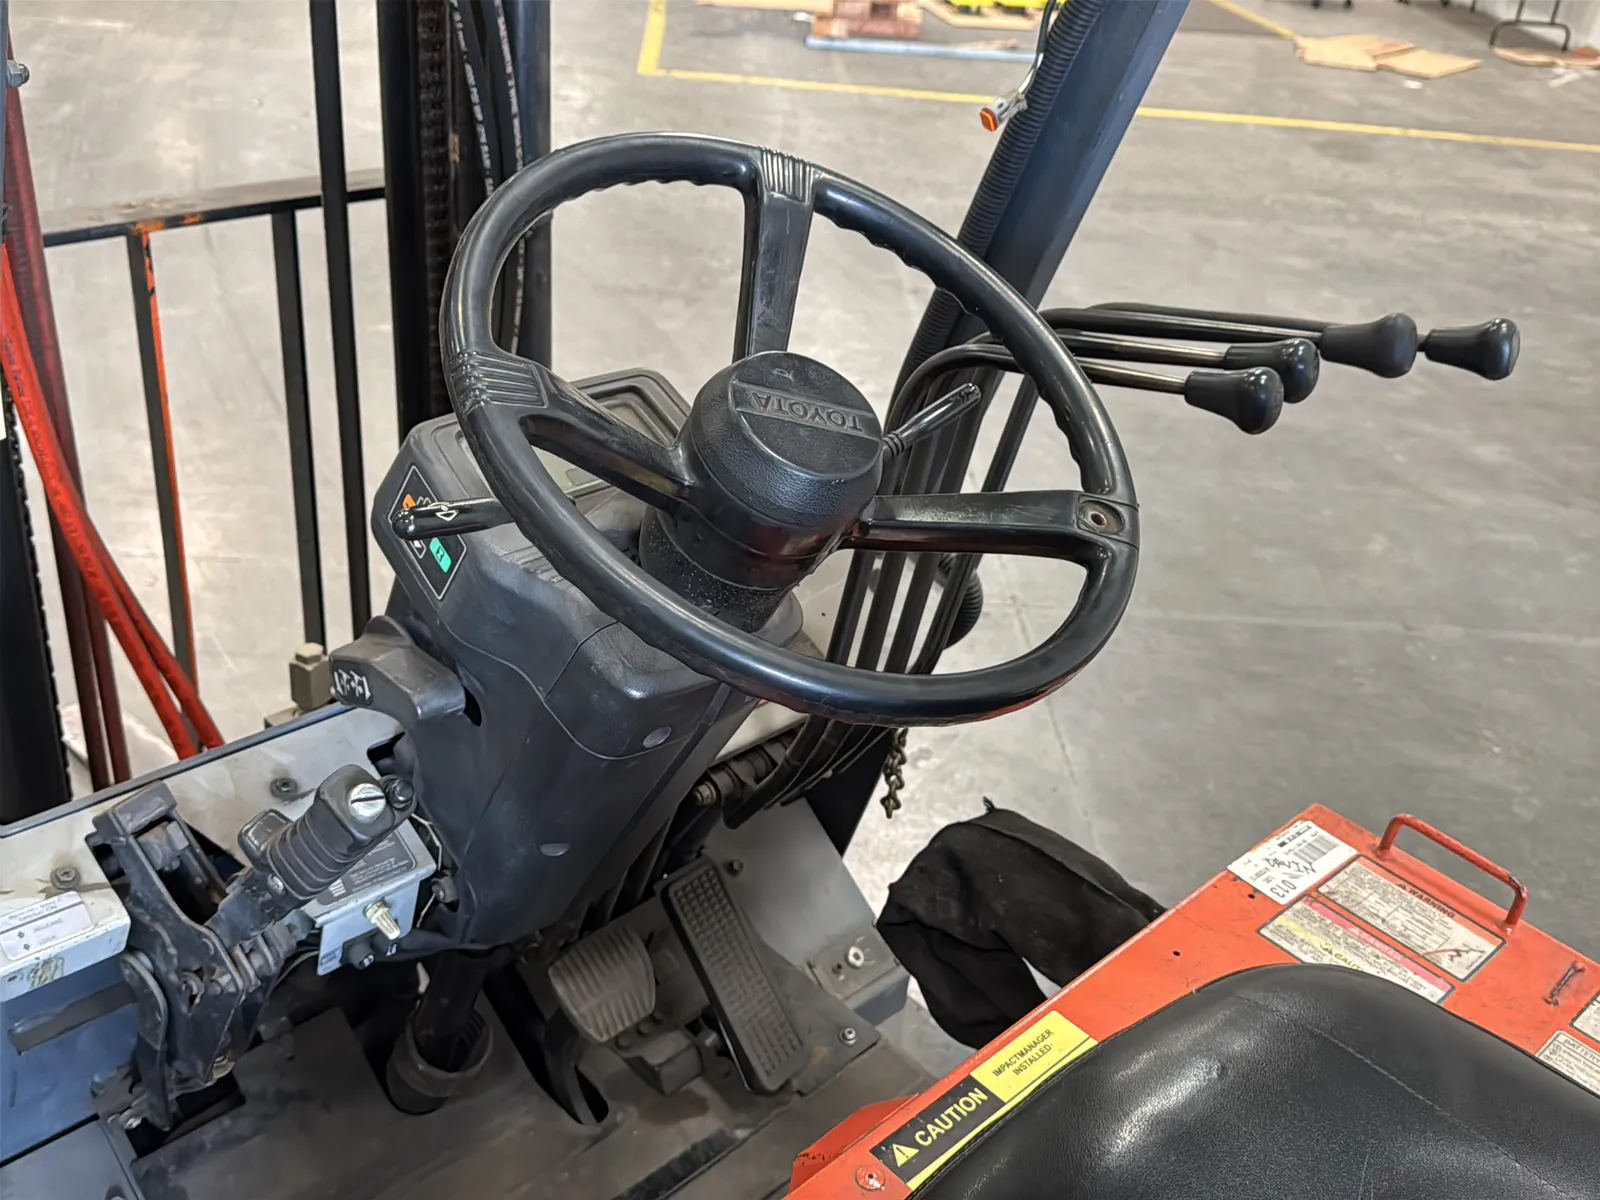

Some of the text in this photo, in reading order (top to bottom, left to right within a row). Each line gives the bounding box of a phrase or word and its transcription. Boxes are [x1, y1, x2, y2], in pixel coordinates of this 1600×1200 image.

[752, 392, 864, 432] TOYOTA
[1270, 879, 1298, 899] 013
[1408, 889, 1456, 919] WARNING
[992, 1029, 1054, 1077] IMPACTMANAGER
[1012, 1044, 1052, 1076] INSTALLED
[914, 1086, 989, 1147] CAUTION
